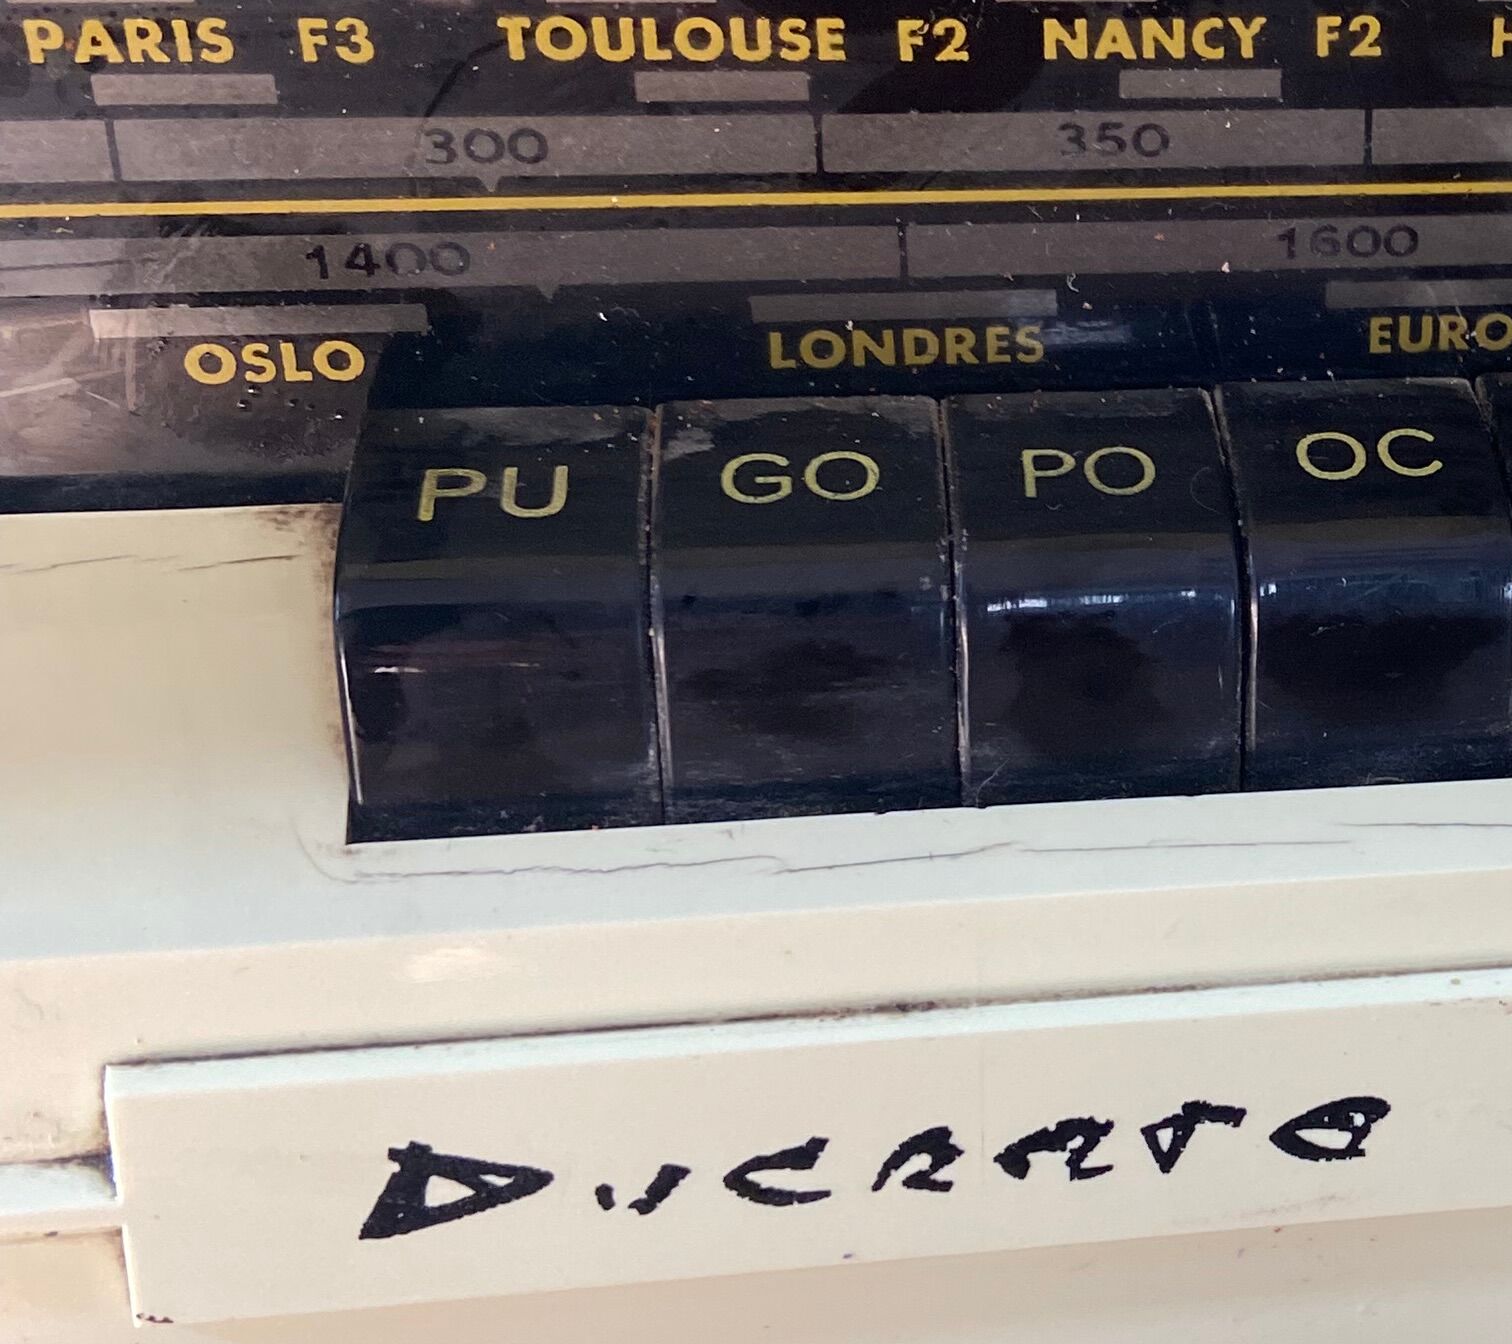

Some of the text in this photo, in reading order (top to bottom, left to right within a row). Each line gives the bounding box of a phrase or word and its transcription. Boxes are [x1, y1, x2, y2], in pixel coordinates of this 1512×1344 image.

[22, 16, 375, 65] PARIS F3
[498, 16, 971, 64] TOULOUSE F2
[1042, 16, 1383, 61] NANCY F2
[422, 127, 549, 165] 300
[1057, 122, 1171, 157] 350
[304, 240, 471, 280] 1400
[1276, 223, 1420, 258] 1600
[183, 339, 366, 386] OSLO
[768, 324, 1045, 370] LONDRES
[720, 450, 880, 504] GO
[1022, 445, 1157, 498] PO
[1296, 427, 1444, 481] OC
[416, 465, 569, 522] PU
